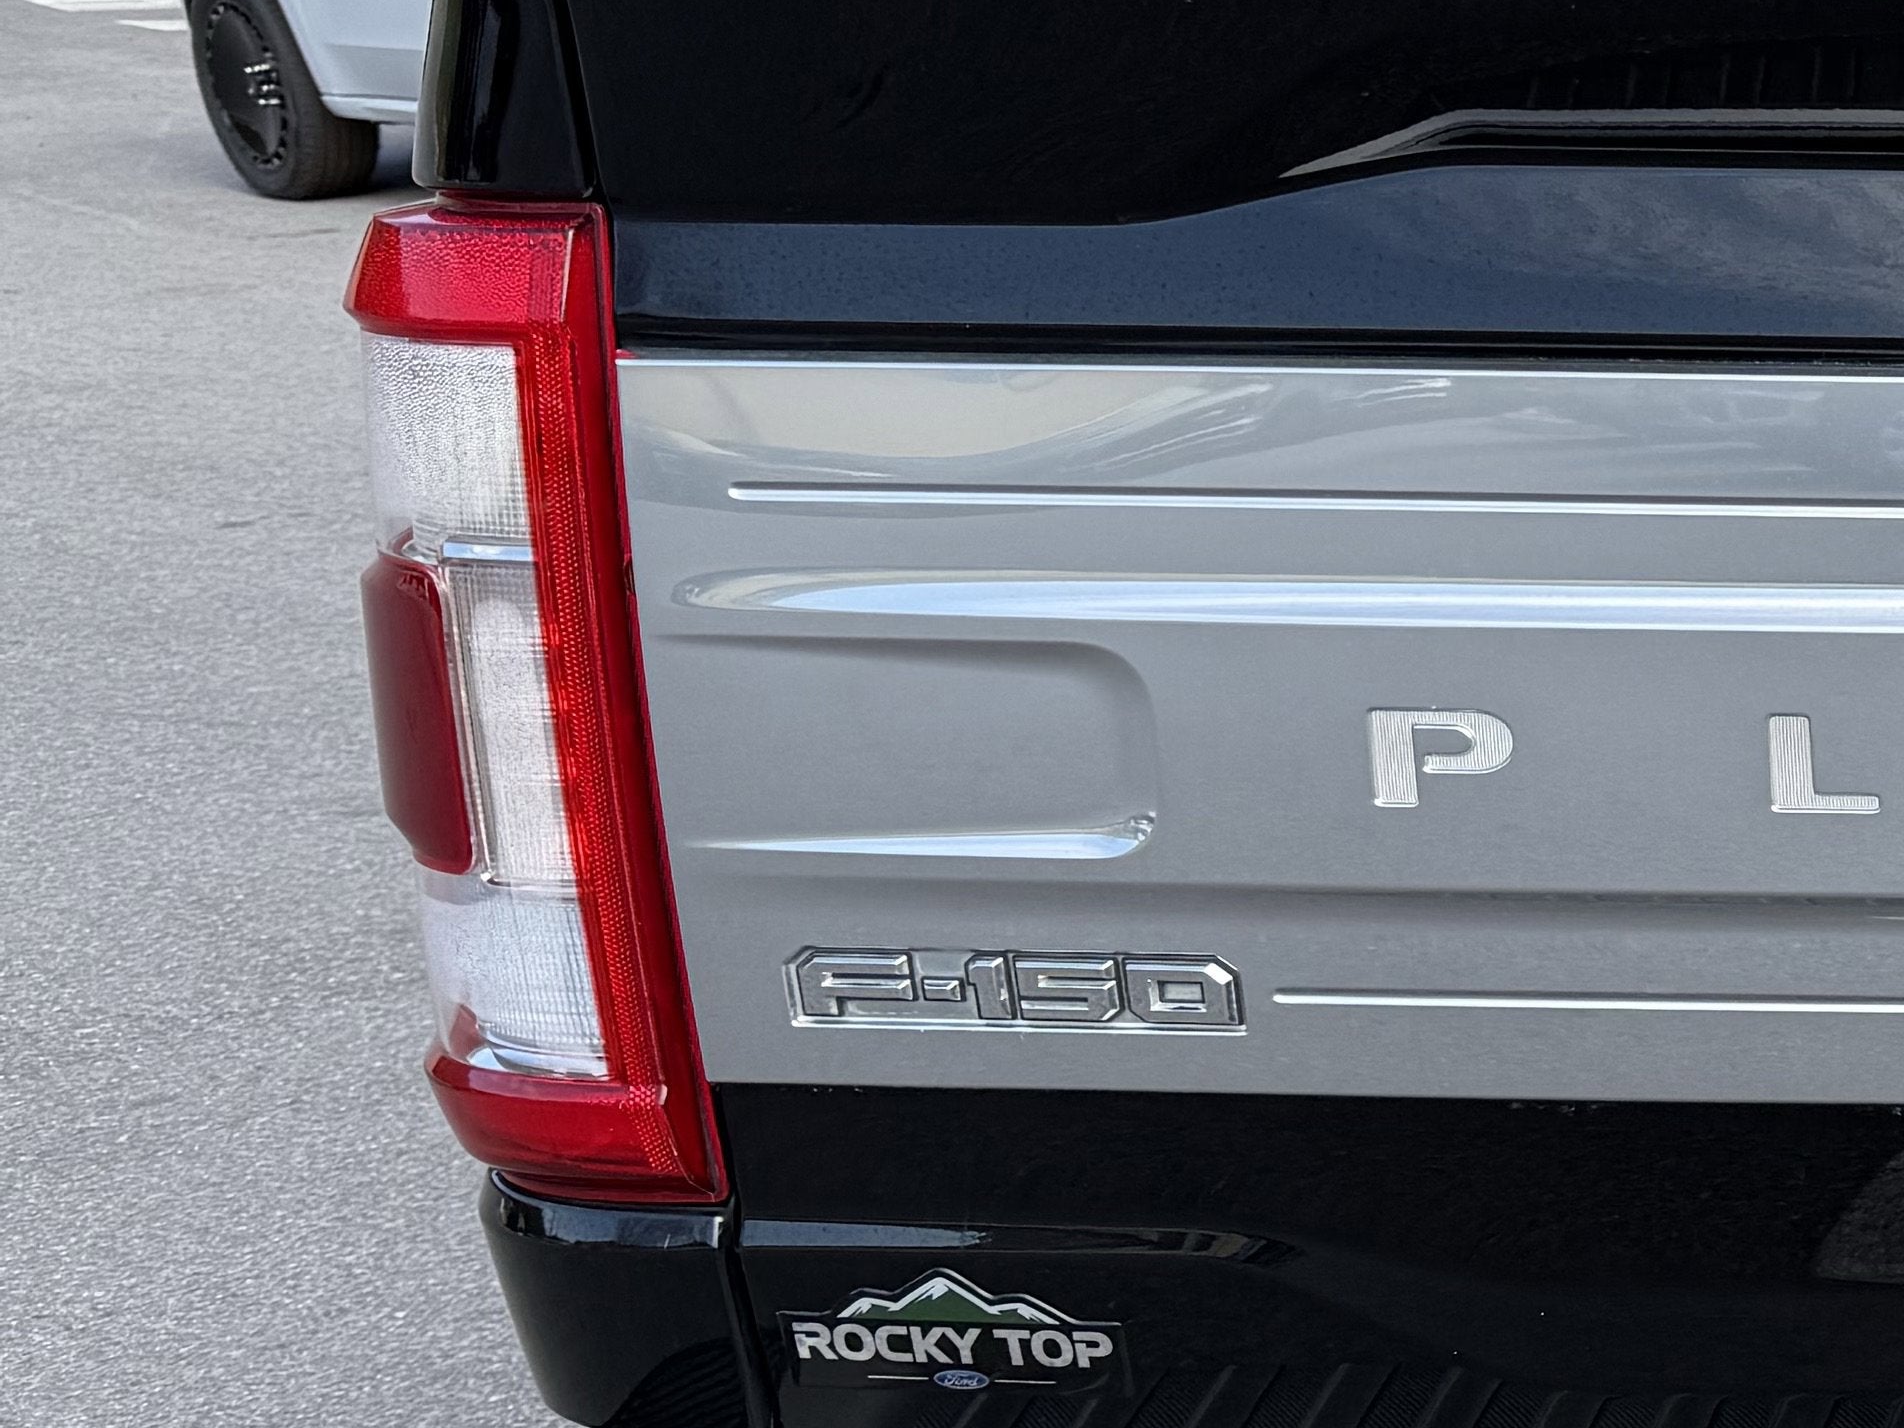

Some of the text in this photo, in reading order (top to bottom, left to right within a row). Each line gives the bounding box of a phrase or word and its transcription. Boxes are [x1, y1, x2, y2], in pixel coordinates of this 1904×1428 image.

[786, 947, 1246, 1033] F-150
[792, 1322, 1114, 1369] ROCKY TOP
